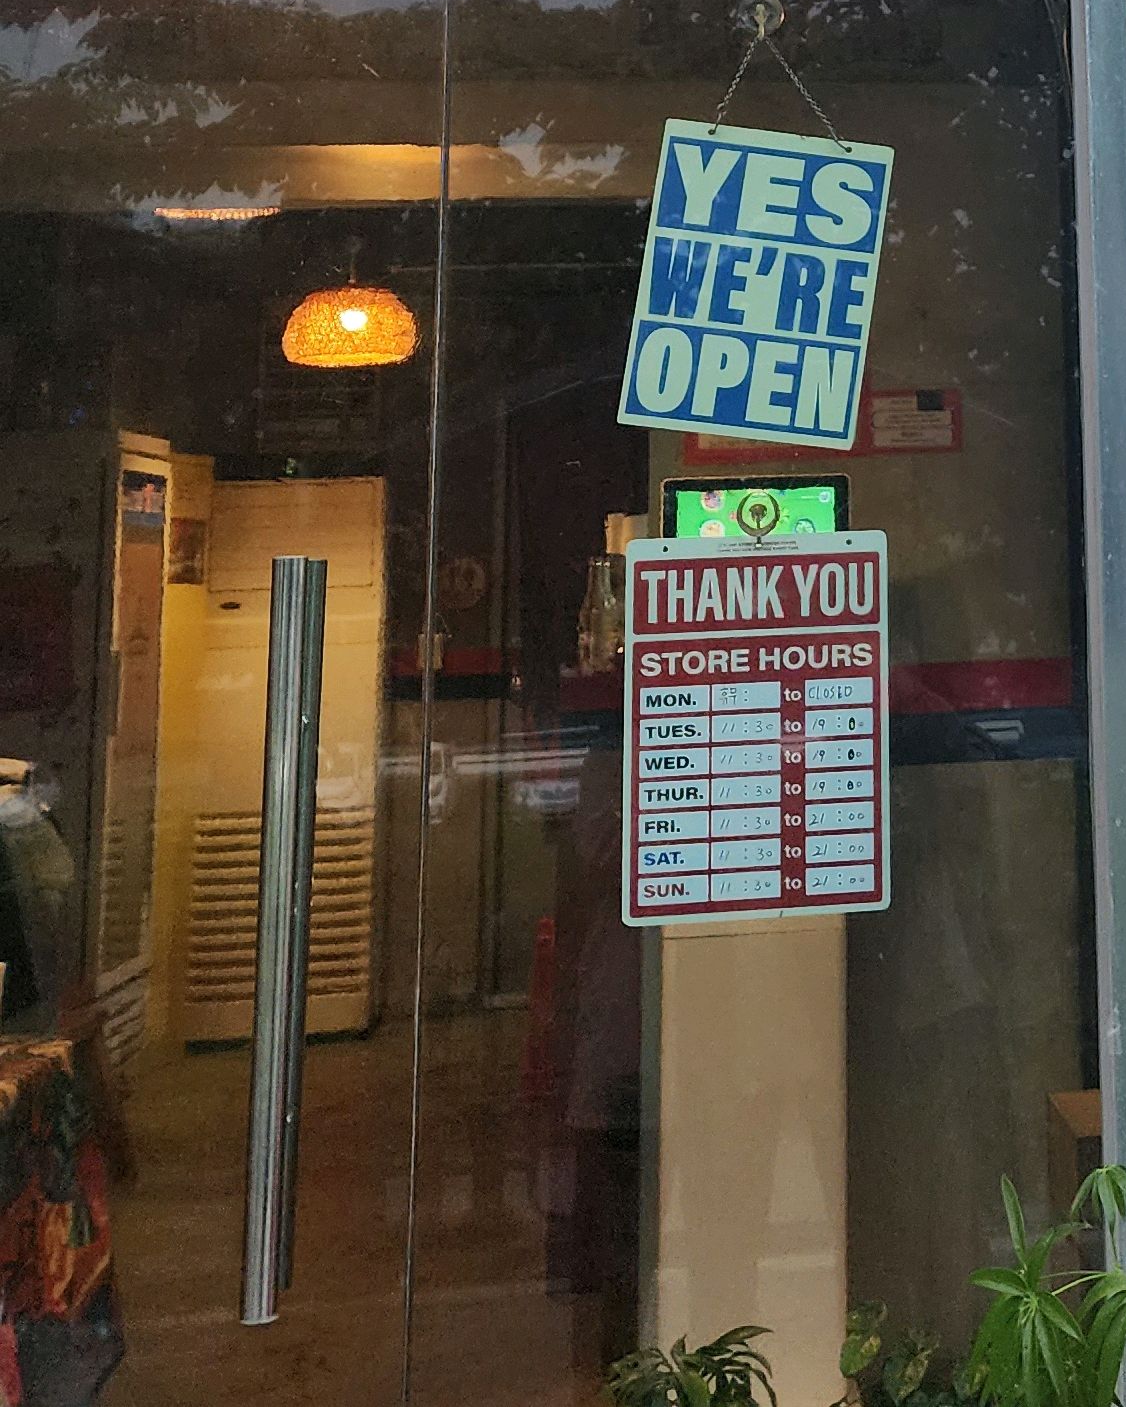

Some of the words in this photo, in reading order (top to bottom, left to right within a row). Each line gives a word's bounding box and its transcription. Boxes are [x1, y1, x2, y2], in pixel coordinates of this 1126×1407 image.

[673, 142, 874, 245] YES
[648, 236, 869, 340] WE'RE
[636, 327, 853, 433] OPEN
[640, 566, 784, 624] THANK
[792, 562, 873, 617] YOU
[640, 649, 750, 677] STORE
[759, 643, 873, 670] HOURS
[645, 693, 697, 707] MON.
[784, 688, 801, 701] to
[645, 724, 702, 739] TUES.
[784, 719, 801, 732] to
[645, 756, 695, 770] WED.
[784, 750, 801, 763] to
[644, 787, 704, 802] THUR.
[784, 782, 801, 794] to
[644, 820, 680, 834] FRI.
[784, 813, 801, 826] to
[644, 852, 684, 866] SAT.
[784, 845, 801, 857] to
[644, 883, 690, 898] SUN.
[784, 876, 801, 889] to
